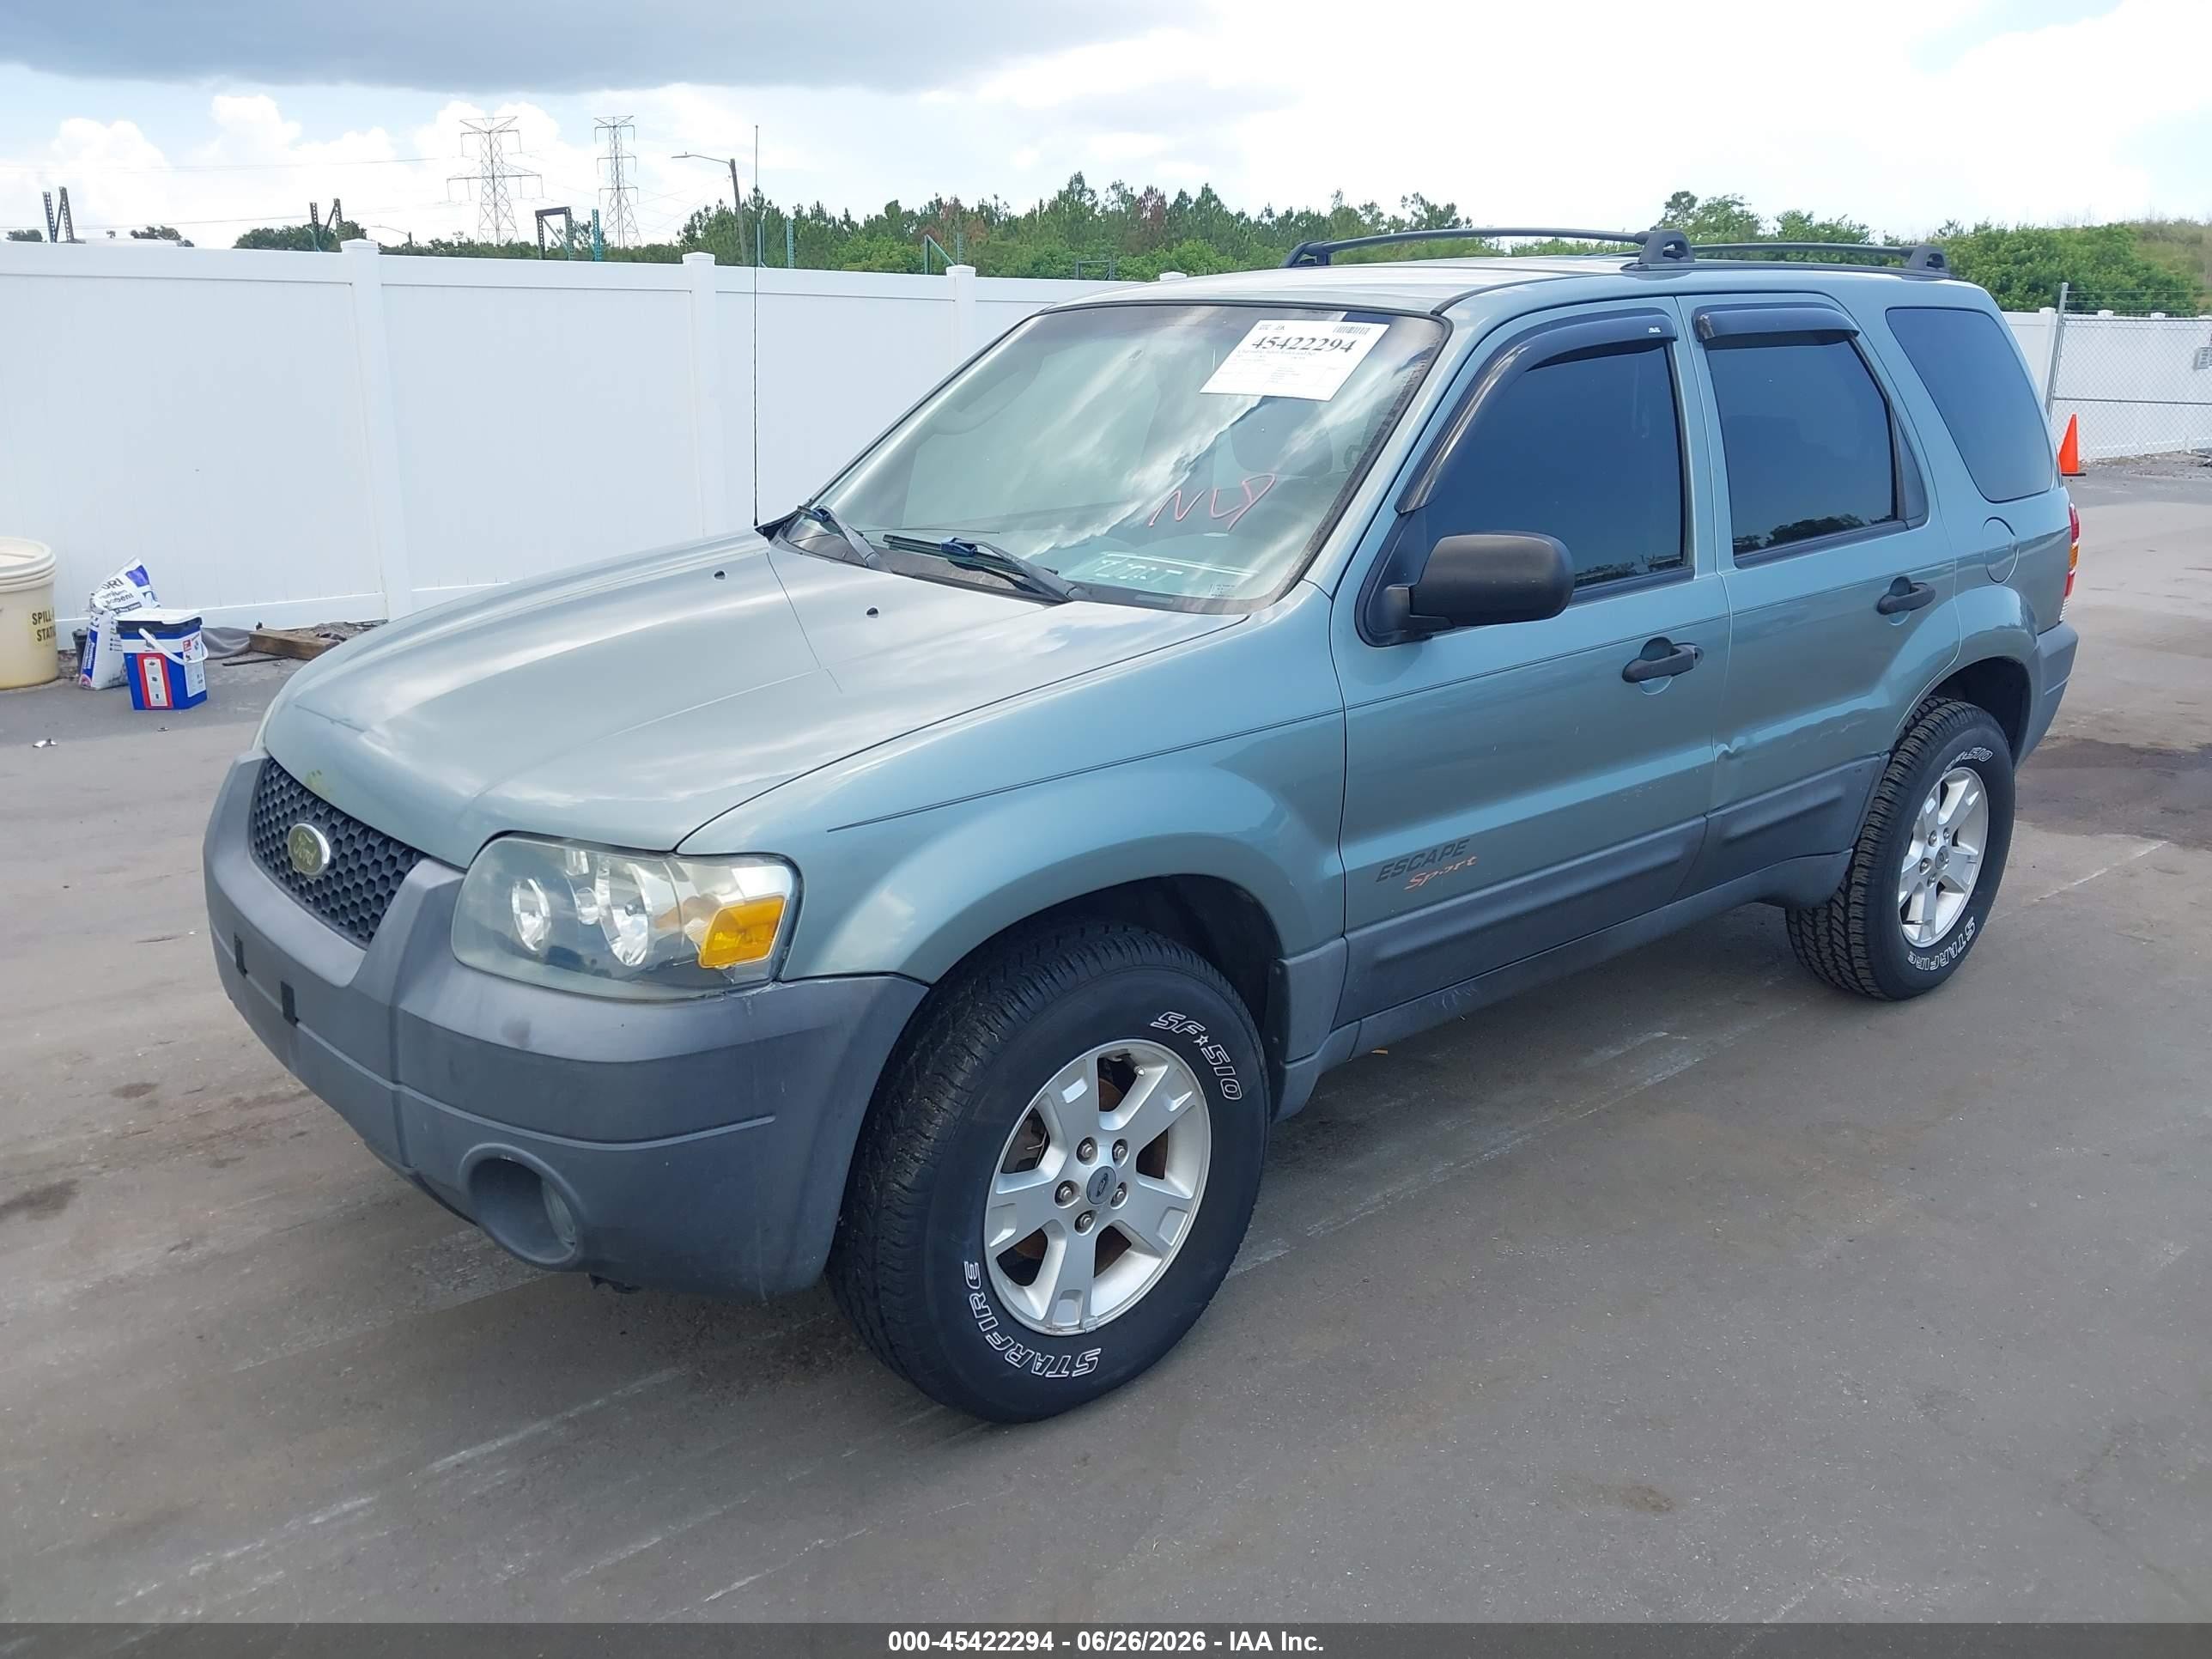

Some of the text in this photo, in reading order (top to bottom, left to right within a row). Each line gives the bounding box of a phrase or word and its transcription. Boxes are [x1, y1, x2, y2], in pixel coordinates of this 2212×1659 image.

[1251, 336, 1358, 353] 45422294
[1376, 838, 1471, 883] ESCAPE
[1403, 855, 1478, 891] Sport
[1907, 915, 1976, 971] STARFIRE
[963, 1261, 1102, 1377] STARFIRE
